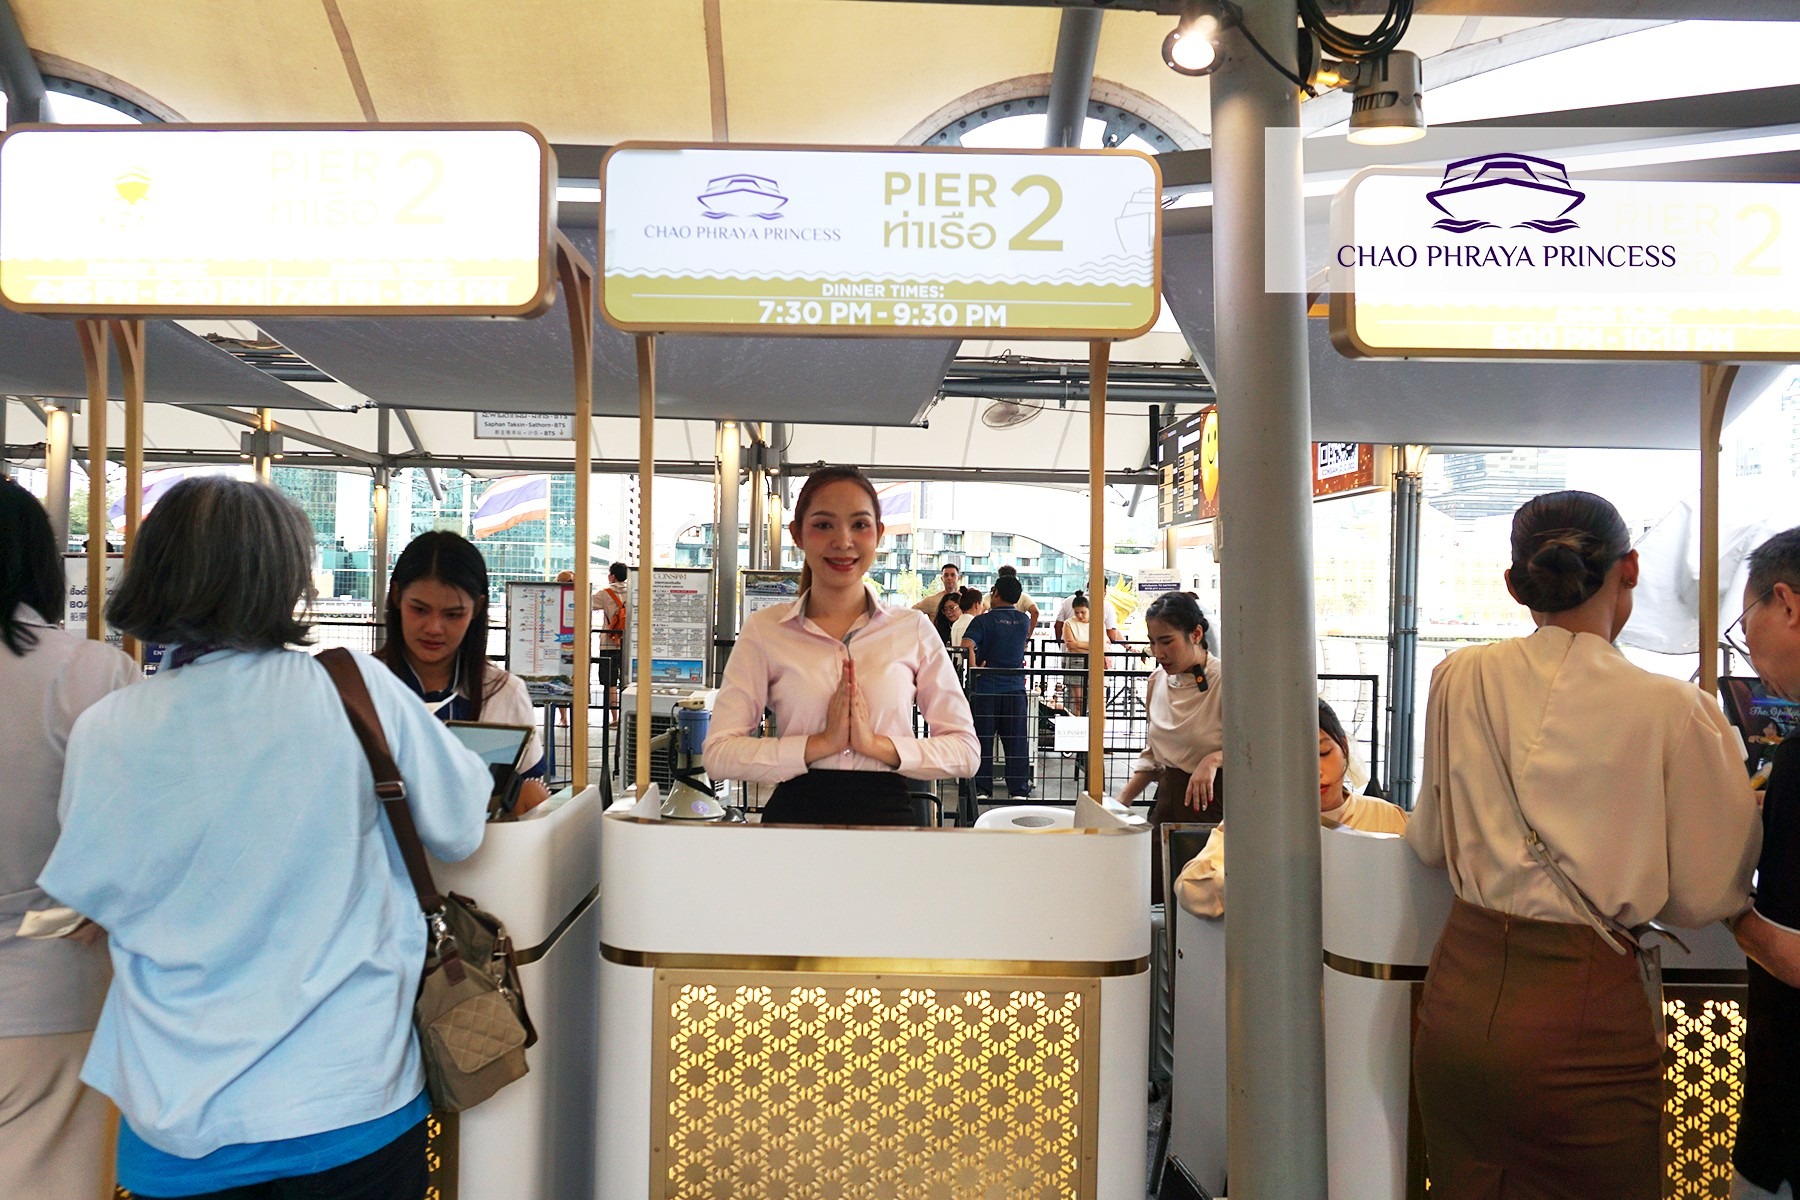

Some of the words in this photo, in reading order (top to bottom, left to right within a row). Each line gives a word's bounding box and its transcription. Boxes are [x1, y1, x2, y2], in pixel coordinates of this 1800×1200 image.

[393, 148, 446, 225] 2
[884, 172, 996, 207] PIER
[1008, 174, 1064, 252] 2
[644, 224, 692, 239] CHAO
[696, 225, 760, 240] PHRAYA
[764, 227, 841, 242] PRINCESS
[884, 210, 996, 250] ท่าเรือ
[1732, 202, 1784, 277] 2
[822, 283, 885, 297] DINNER
[890, 284, 945, 299] TIMES:
[758, 300, 823, 324] 7:30
[830, 302, 872, 325] PM
[893, 303, 958, 326] 9:30
[966, 304, 1007, 327] PM
[1562, 326, 1603, 350] PM
[1695, 327, 1735, 351] PM
